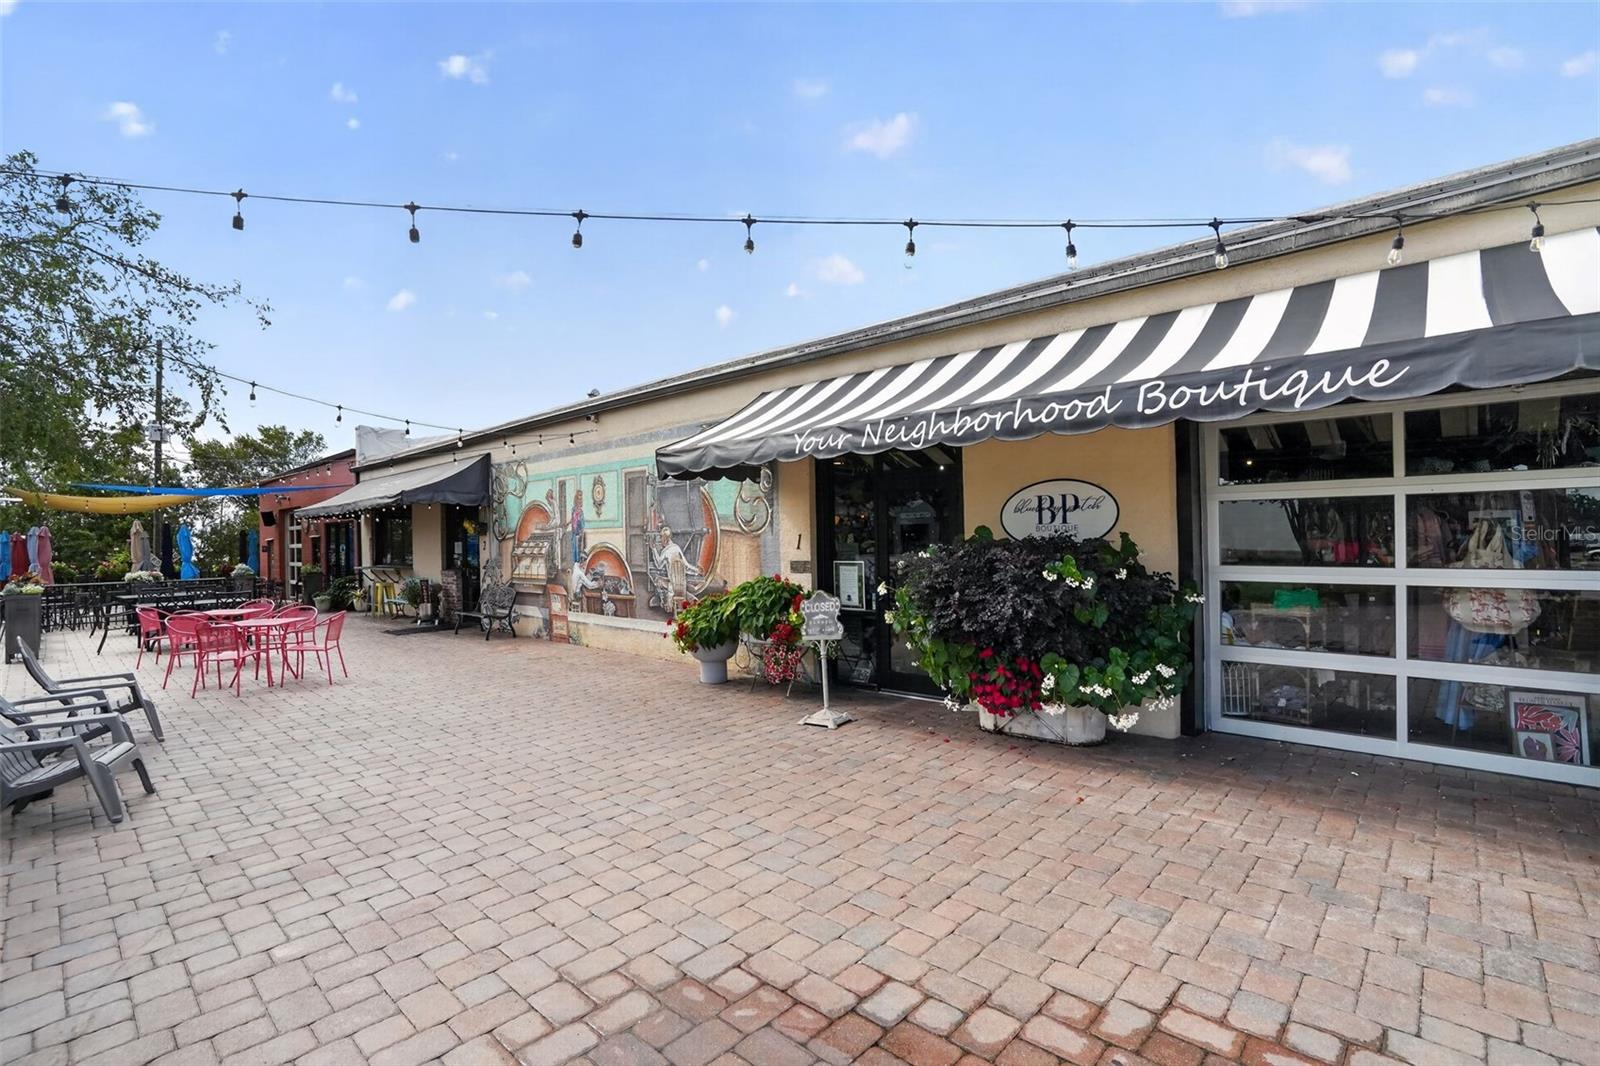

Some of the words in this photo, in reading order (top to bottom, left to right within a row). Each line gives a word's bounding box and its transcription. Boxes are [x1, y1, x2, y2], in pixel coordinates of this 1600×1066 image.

[794, 431, 852, 454] Your
[861, 386, 1123, 448] Neighborhood
[1137, 359, 1410, 414] Boutique
[1034, 494, 1079, 524] BP
[804, 602, 836, 613] CLOSED
